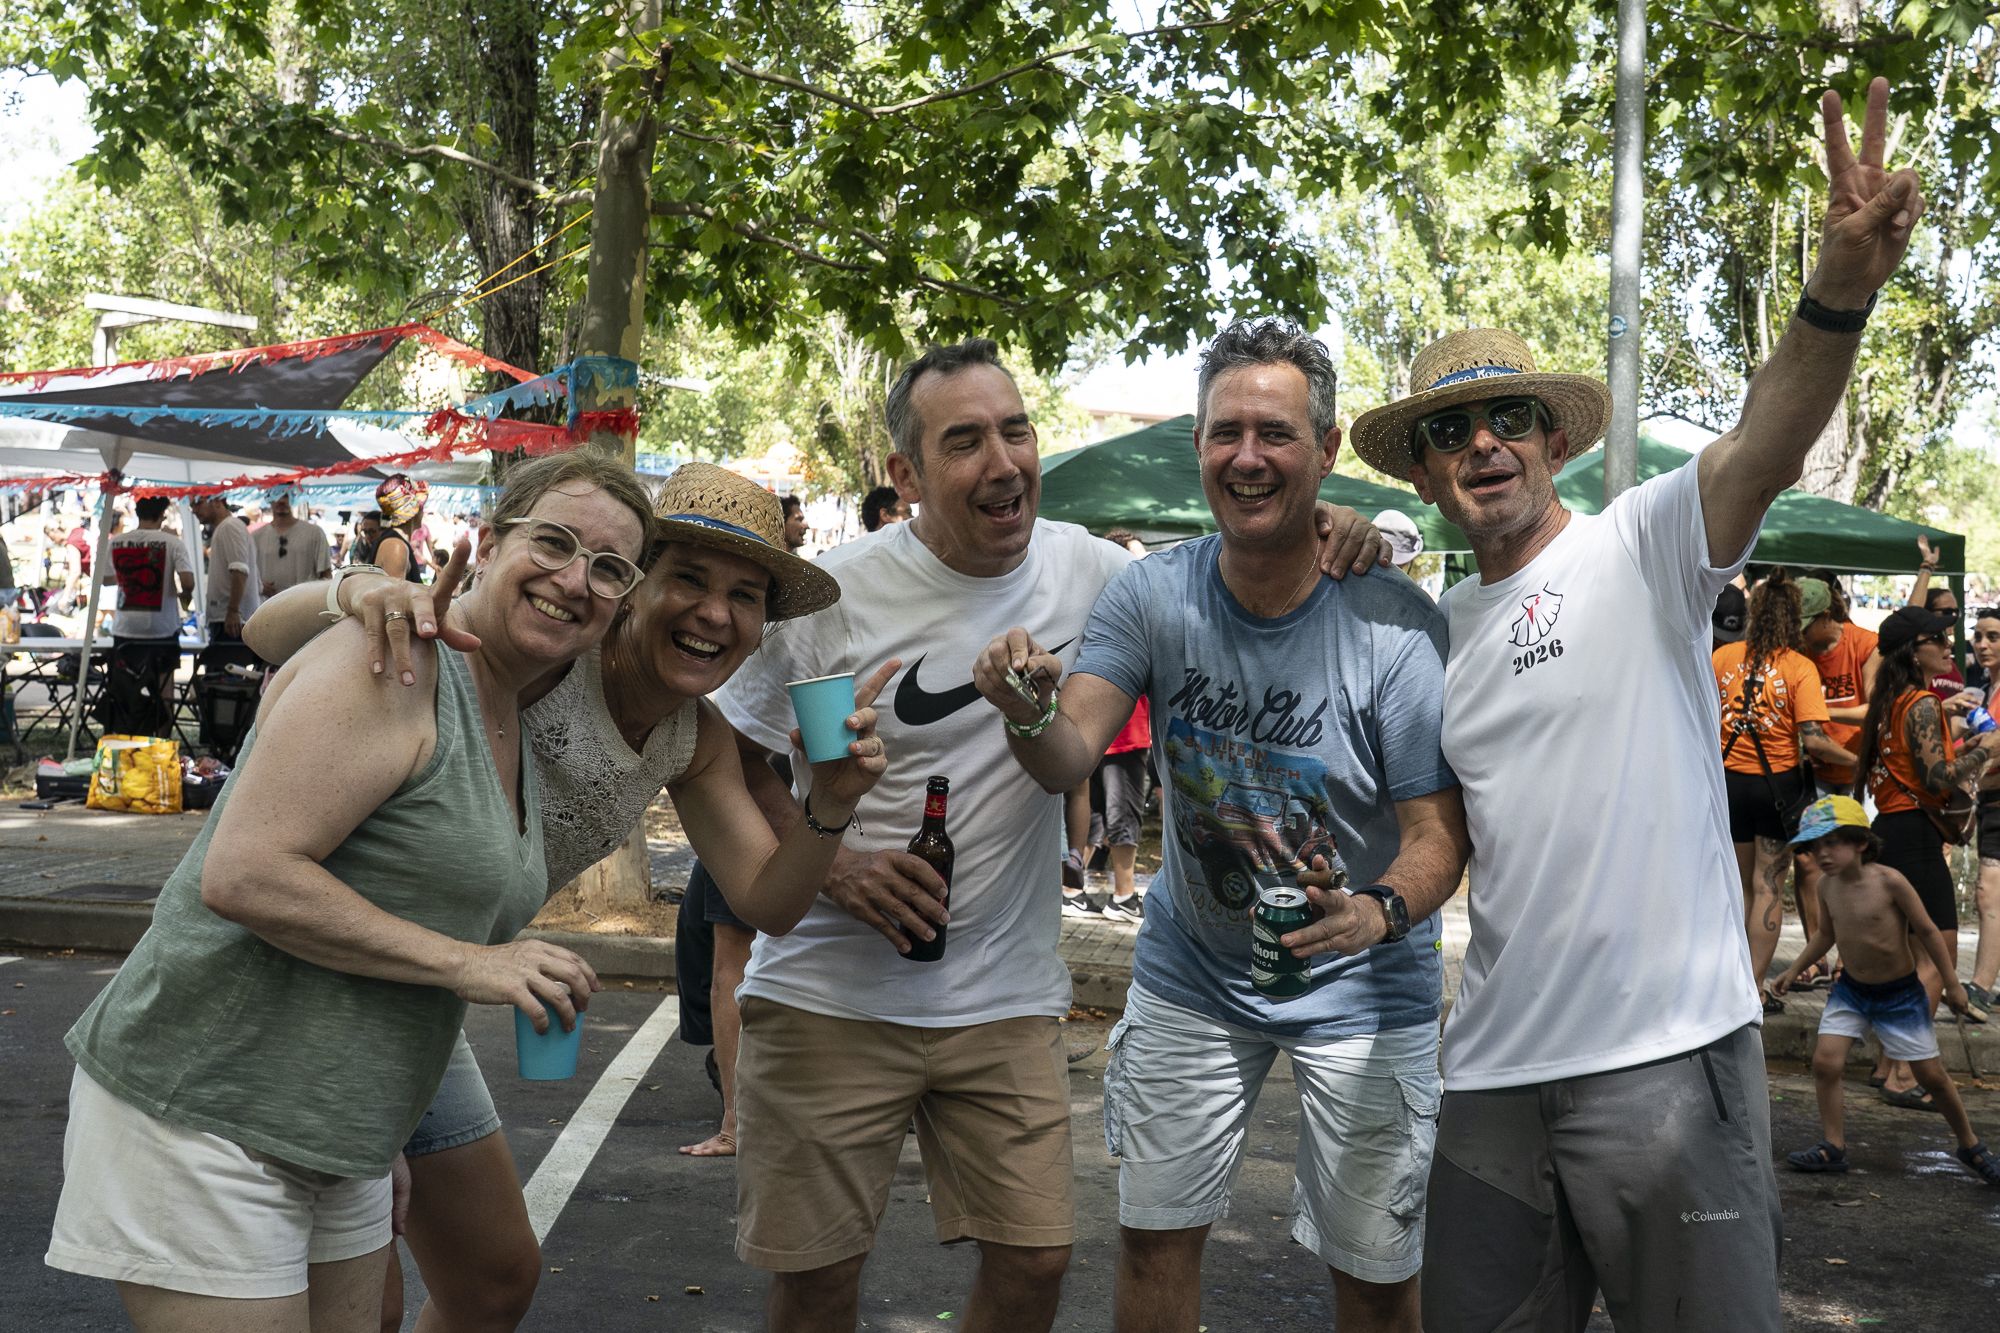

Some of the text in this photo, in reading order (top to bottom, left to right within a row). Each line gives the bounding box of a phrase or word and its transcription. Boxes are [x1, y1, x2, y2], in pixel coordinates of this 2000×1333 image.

[1512, 638, 1564, 677] 2026
[1821, 673, 1854, 687] ONES
[1168, 667, 1328, 748] Motor Club
[1252, 942, 1280, 961] ahou
[1691, 1208, 1740, 1222] Columbia
